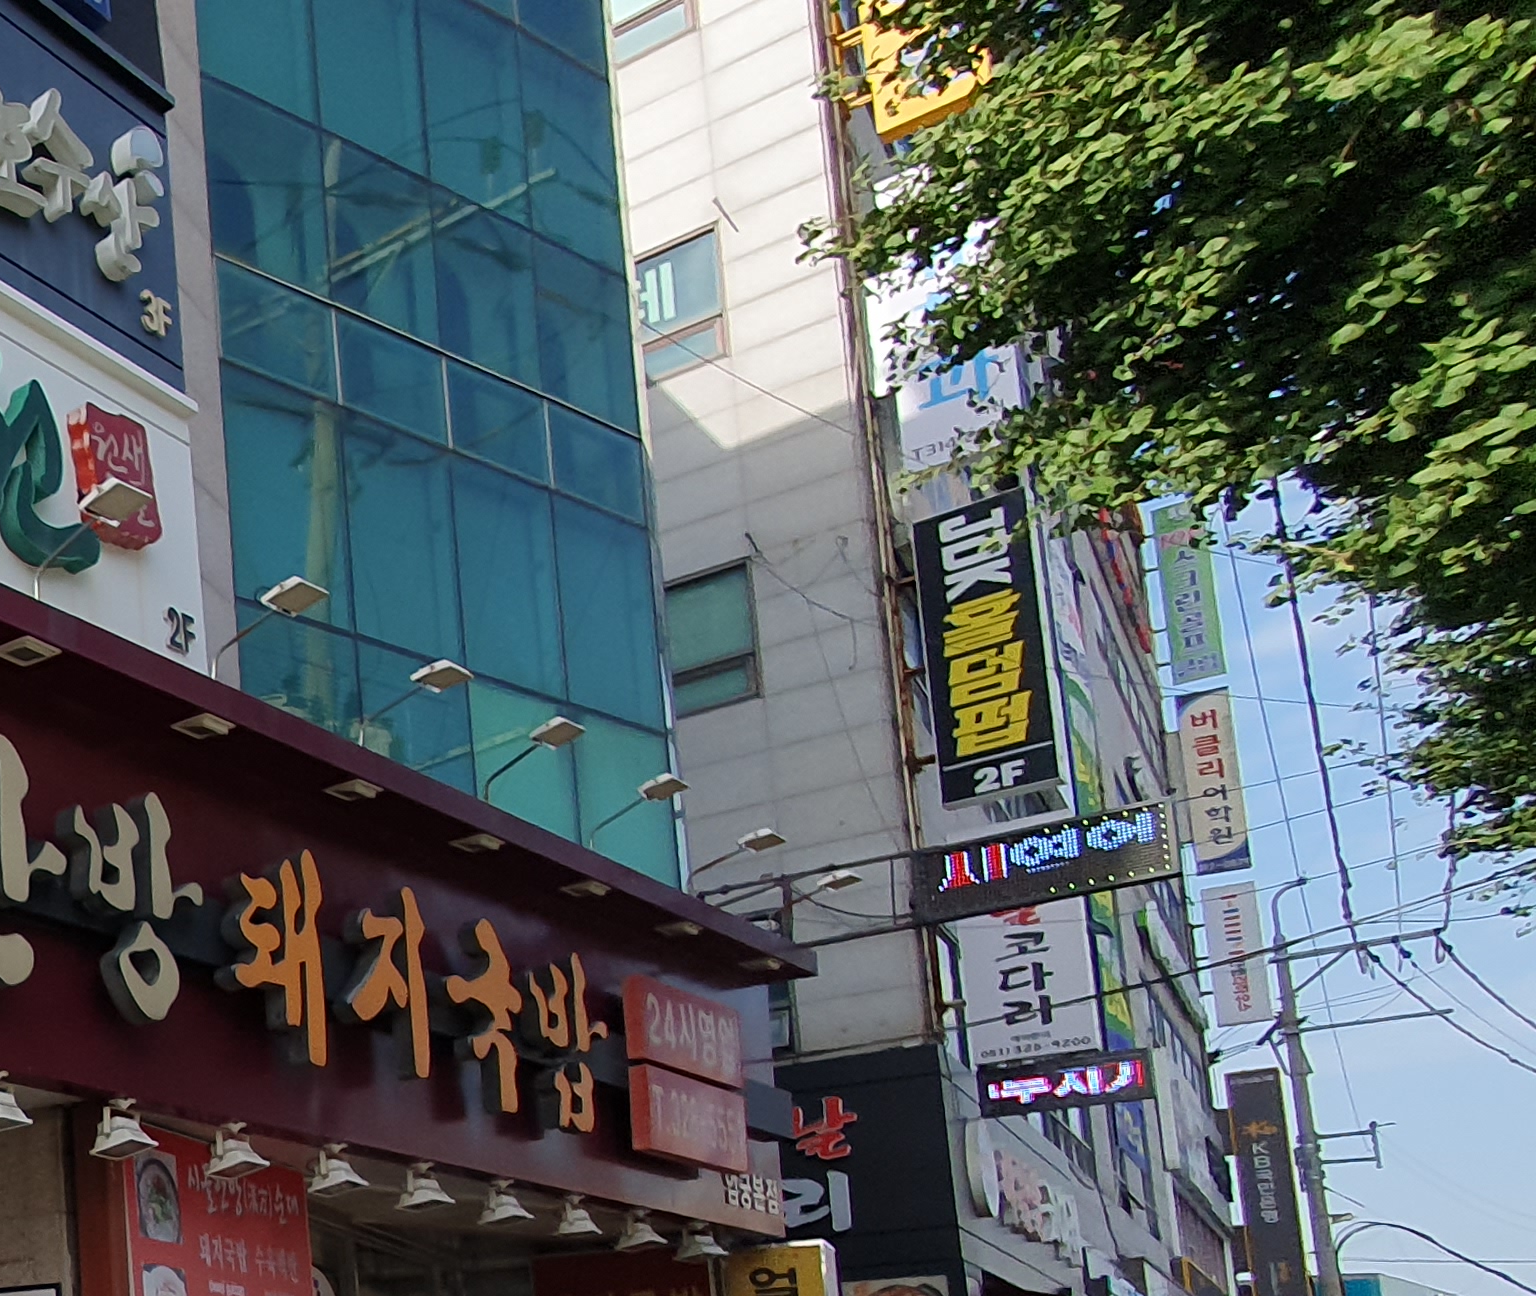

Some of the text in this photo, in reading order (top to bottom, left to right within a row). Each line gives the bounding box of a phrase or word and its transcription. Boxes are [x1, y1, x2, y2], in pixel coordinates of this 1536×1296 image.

[139, 288, 174, 338] 3F
[163, 605, 197, 656] 2F
[972, 758, 1026, 794] 2F
[216, 847, 610, 1135] 돼지국밥
